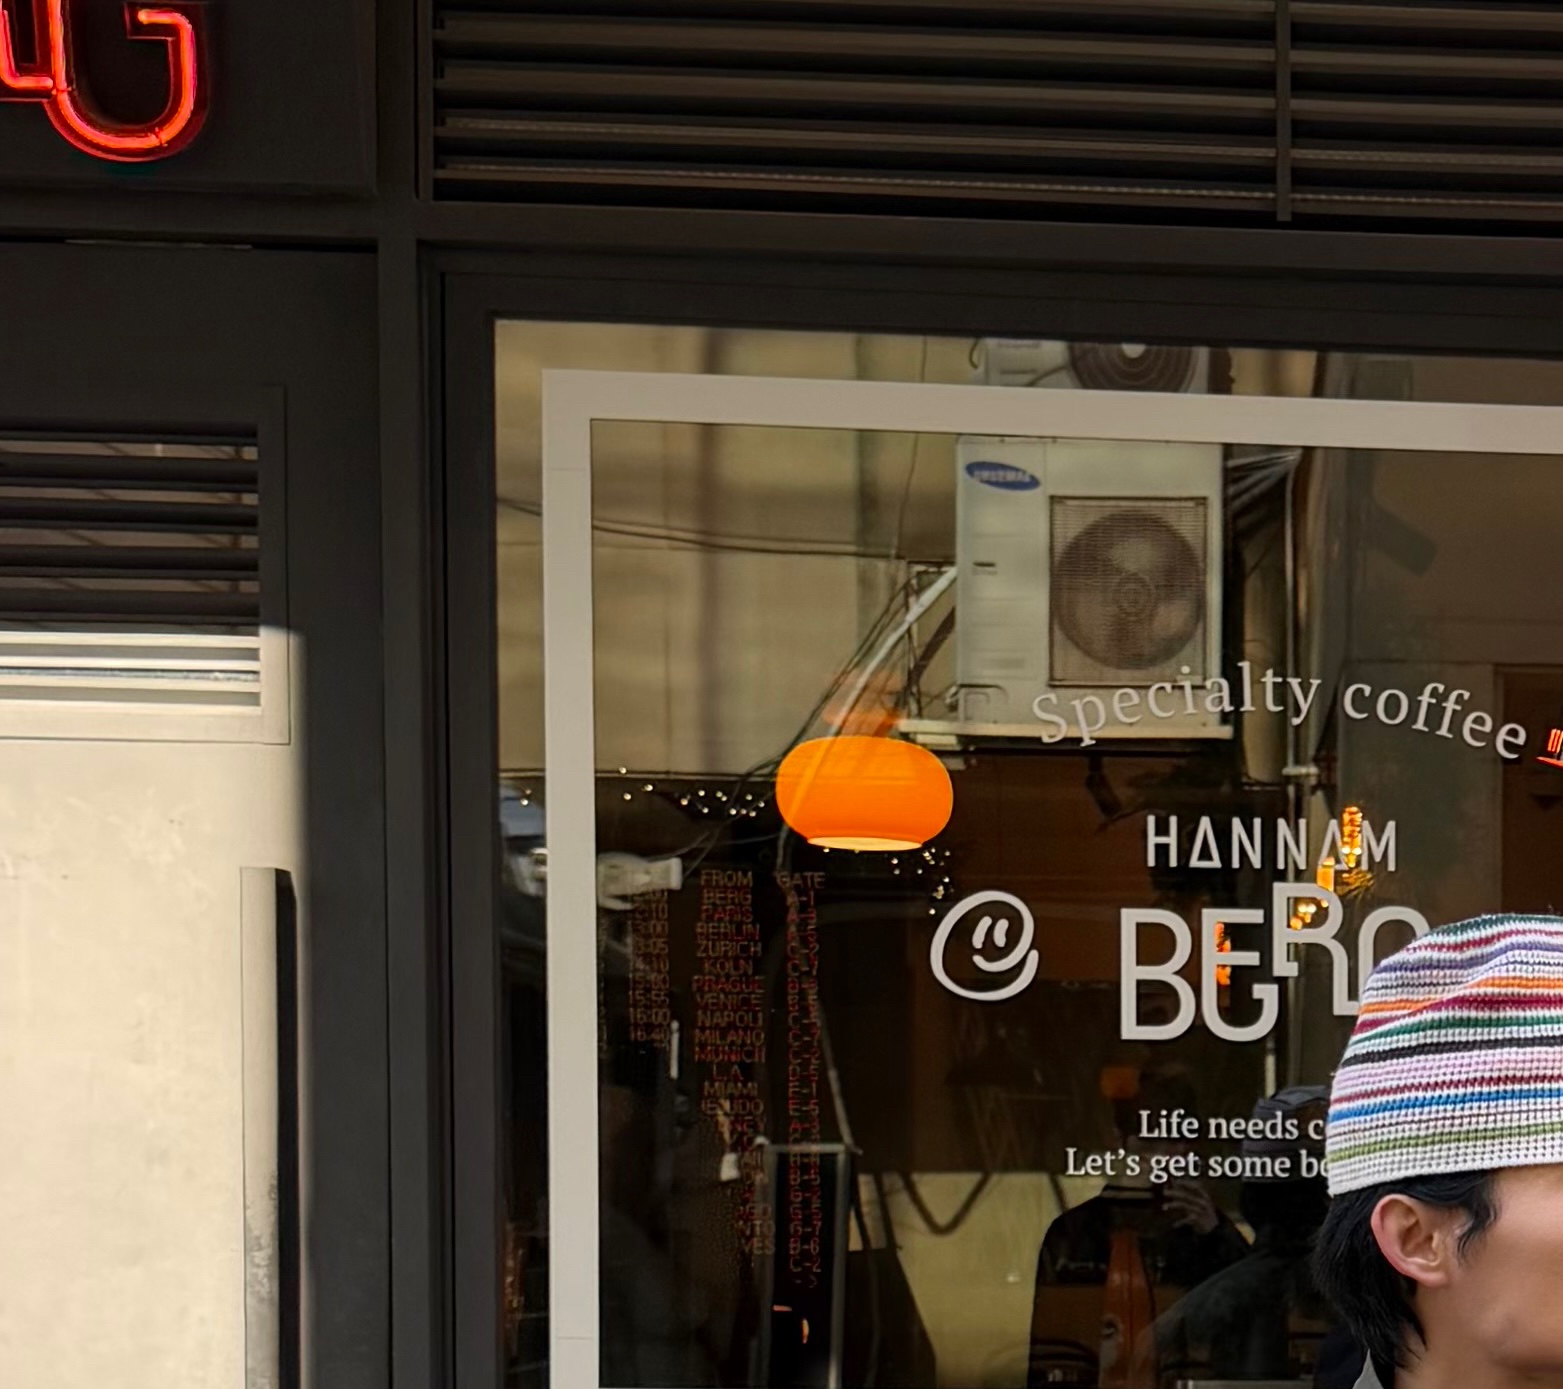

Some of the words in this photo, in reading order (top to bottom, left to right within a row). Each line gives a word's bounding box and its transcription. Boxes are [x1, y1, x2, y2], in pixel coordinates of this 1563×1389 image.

[1032, 661, 1322, 748] Specialty
[1344, 682, 1528, 759] coffee
[1146, 814, 1398, 872] HANNAM
[701, 871, 753, 887] FROM
[691, 976, 766, 992] PRAGUE
[697, 993, 764, 1009] VENICE
[697, 1011, 764, 1027] NAPOLI
[695, 1028, 765, 1044] MILANO
[695, 1046, 766, 1063] MUNICH
[1139, 1109, 1200, 1139] Life
[1208, 1111, 1299, 1140] needs
[1065, 1146, 1141, 1177] Let's
[1149, 1152, 1201, 1183] get
[1208, 1155, 1291, 1178] some
